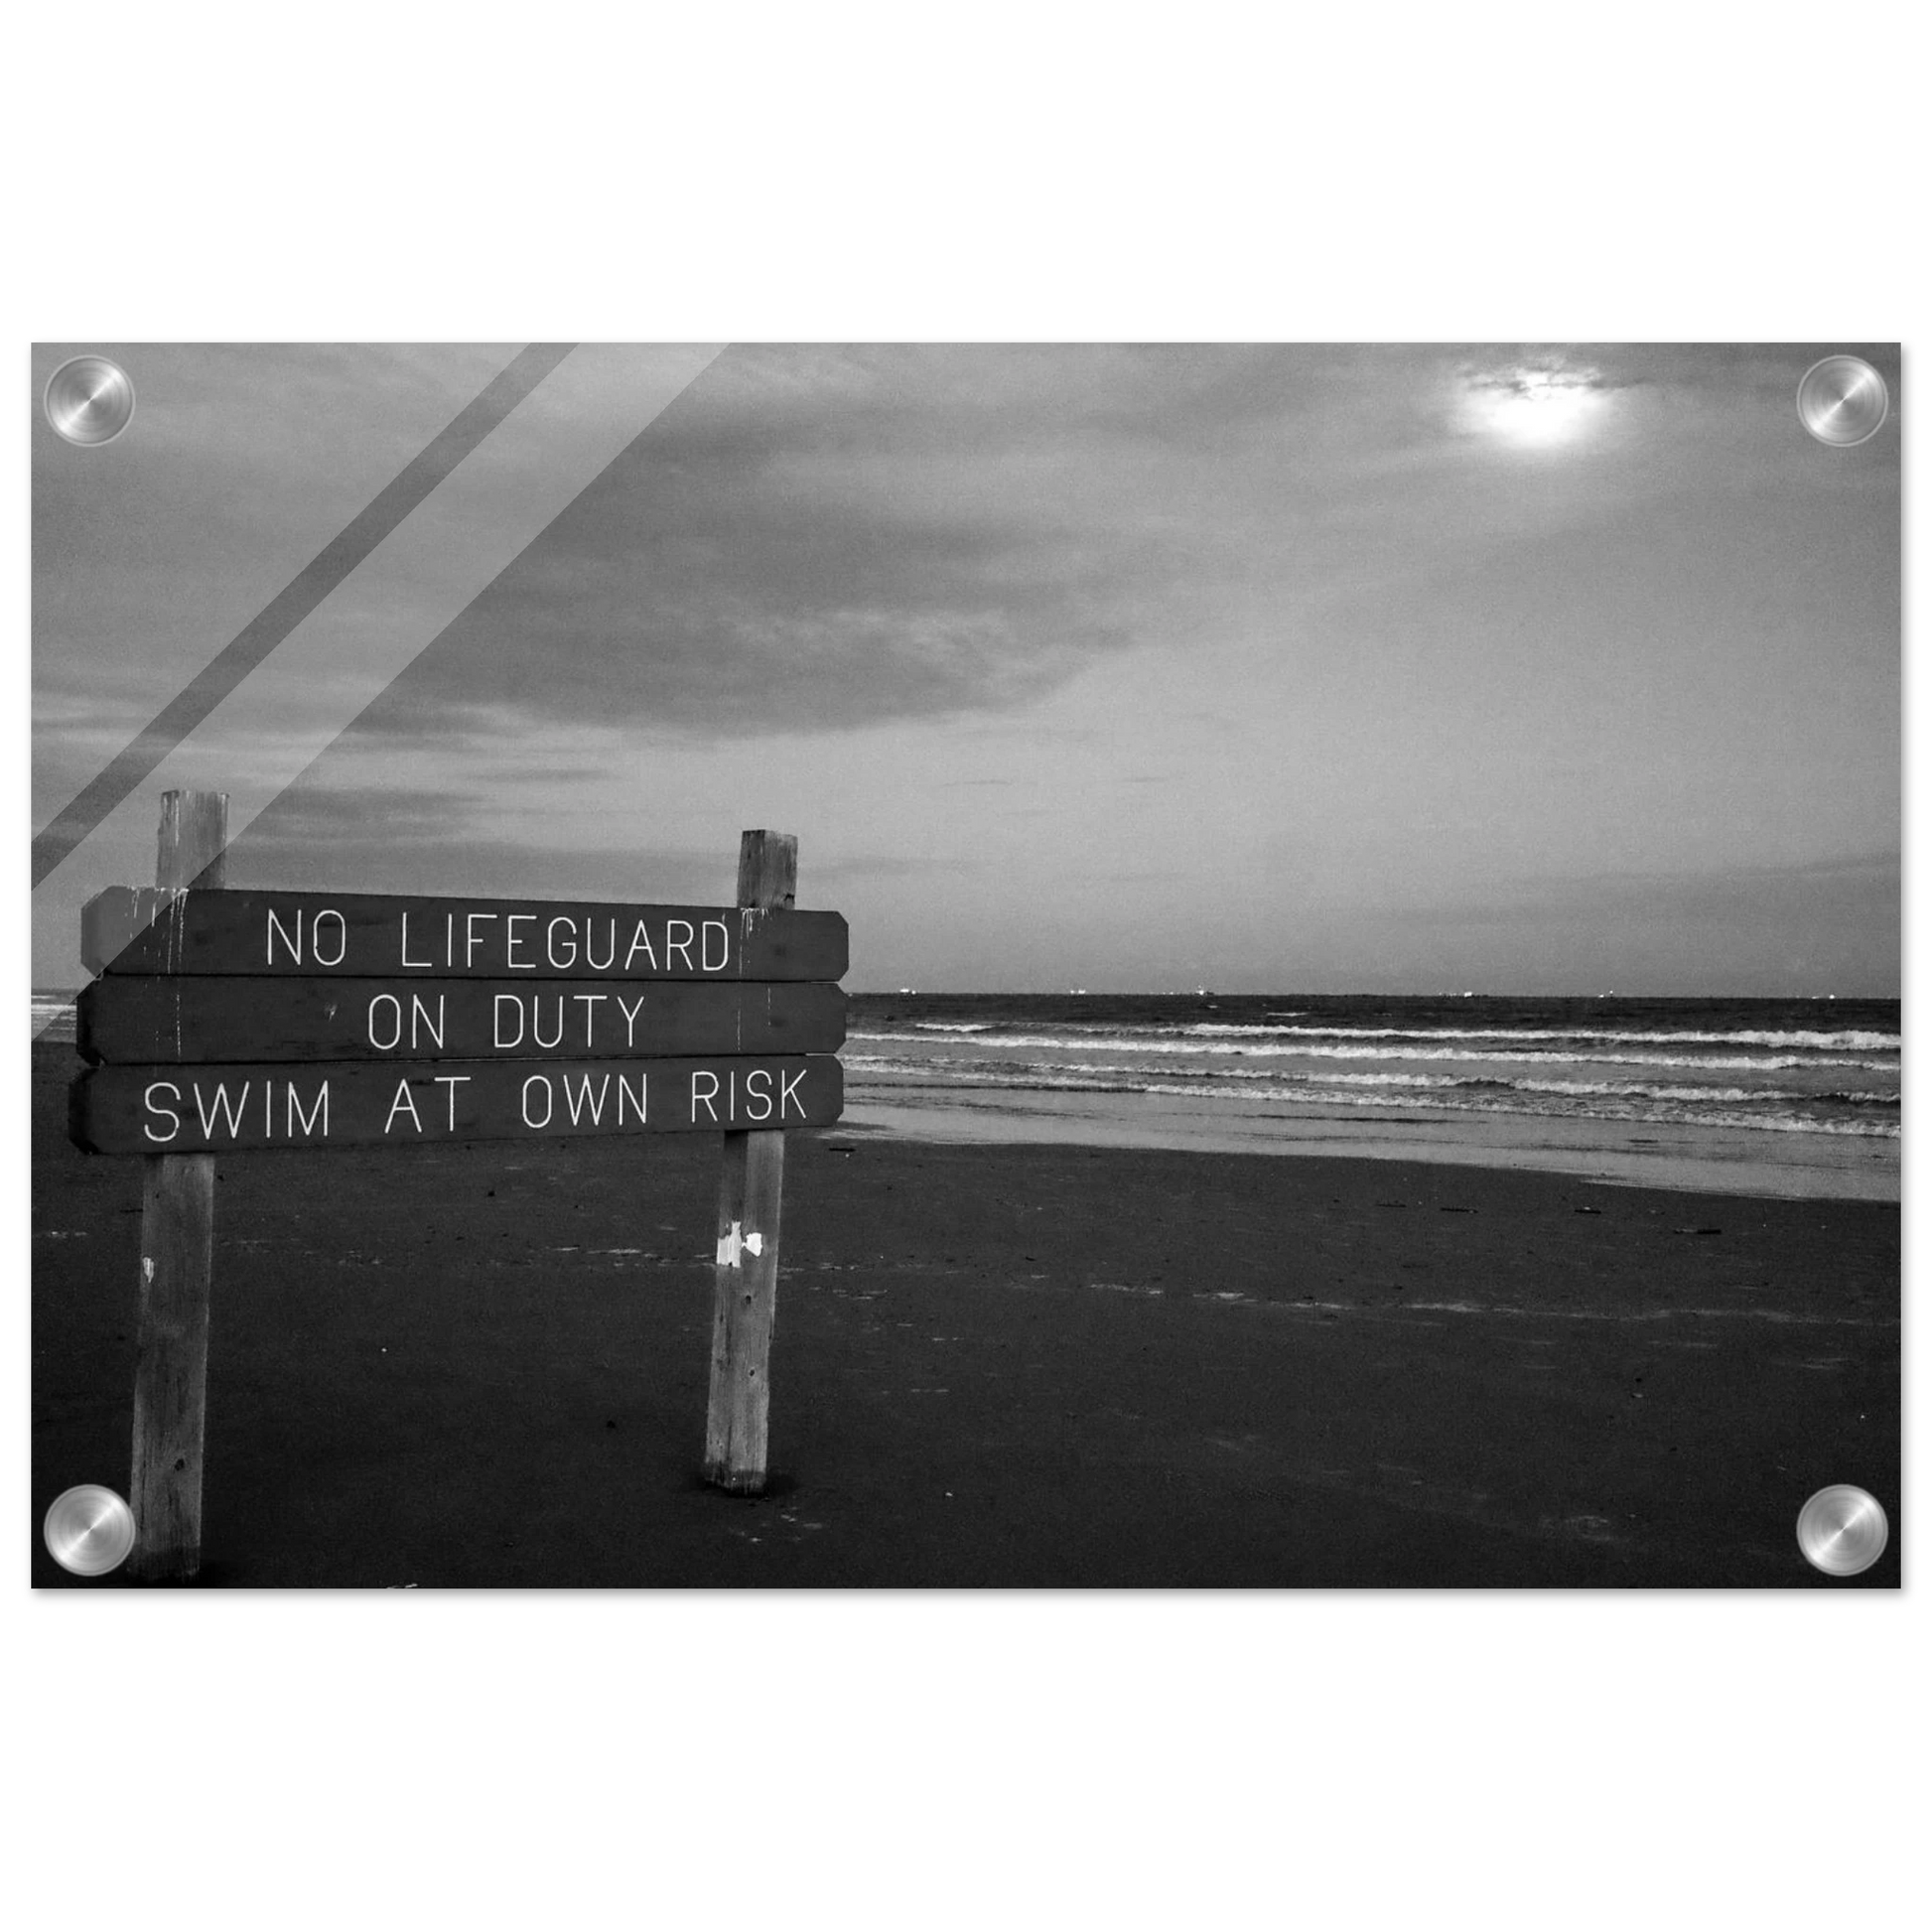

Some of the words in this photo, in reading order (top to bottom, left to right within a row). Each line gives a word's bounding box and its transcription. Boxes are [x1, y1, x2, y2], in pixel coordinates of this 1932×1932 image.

[267, 908, 346, 966] NO
[401, 912, 731, 972] LIFEGUARD
[368, 994, 445, 1050] ON
[493, 994, 644, 1048] DUTY
[144, 1079, 329, 1143] SWIM
[384, 1076, 472, 1134] AT
[522, 1072, 647, 1129] OWN
[691, 1068, 807, 1124] RISK
